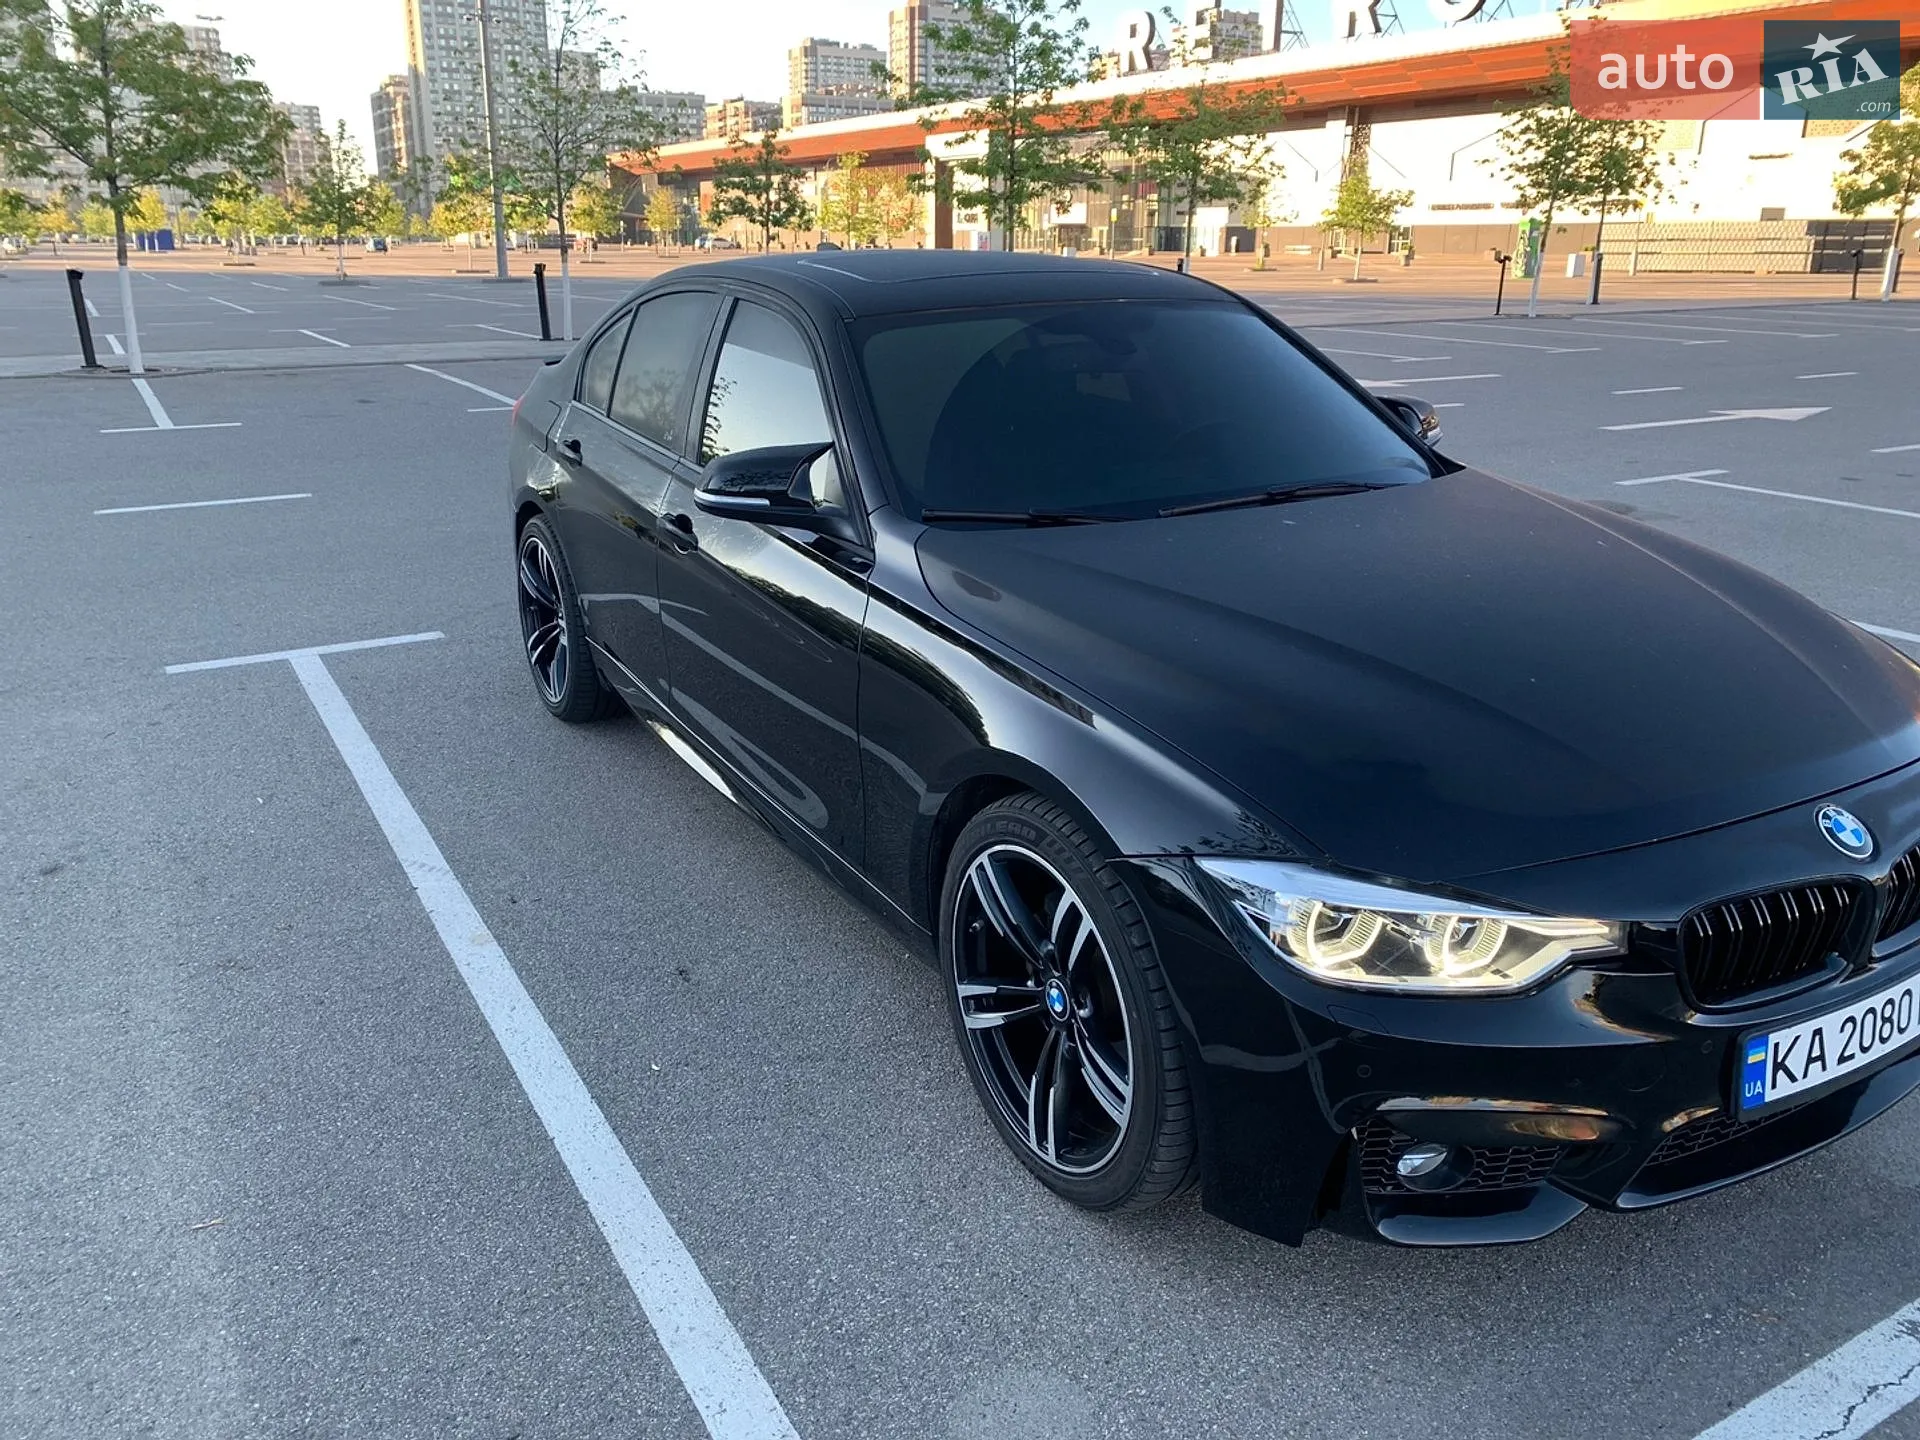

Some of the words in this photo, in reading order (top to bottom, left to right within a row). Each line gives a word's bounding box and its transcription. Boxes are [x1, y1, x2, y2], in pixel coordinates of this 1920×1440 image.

[1771, 1027, 1828, 1090] KA
[1836, 988, 1913, 1066] 2080
[1745, 1081, 1763, 1098] UA
